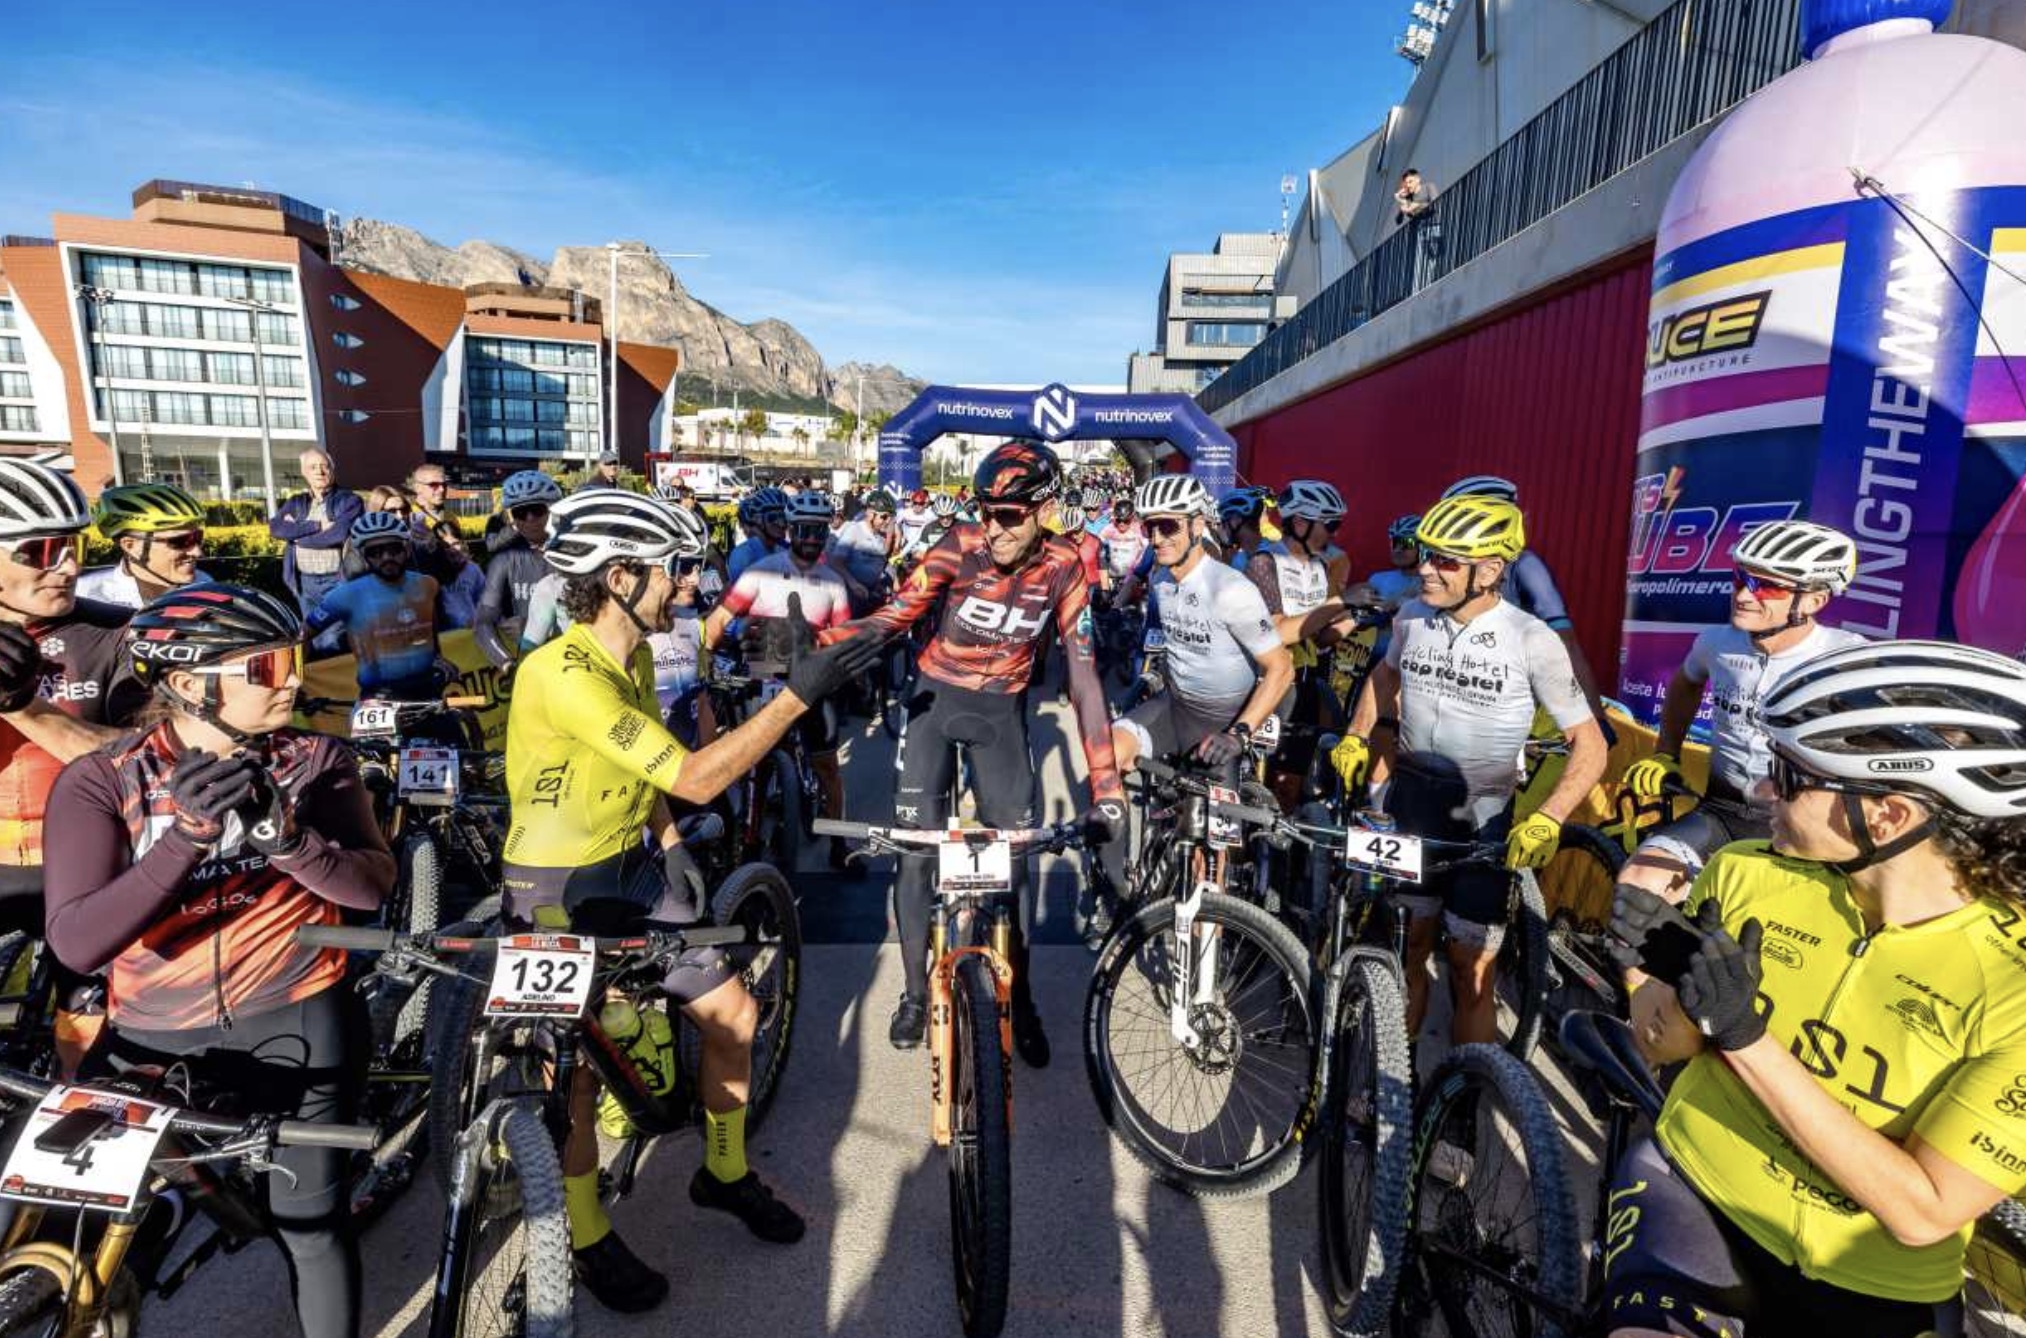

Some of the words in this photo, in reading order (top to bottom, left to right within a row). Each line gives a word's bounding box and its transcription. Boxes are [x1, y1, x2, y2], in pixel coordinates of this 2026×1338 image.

[938, 402, 1013, 420] nutrinovex
[1095, 409, 1173, 423] nutrinovex
[957, 596, 1053, 637] BH
[1461, 653, 1508, 680] Hotel
[357, 709, 387, 725] 161
[408, 763, 449, 784] 141
[1876, 758, 1927, 772] ABUS
[1366, 837, 1402, 861] 42
[1765, 920, 1822, 948] FASTER
[511, 957, 579, 994] 132
[61, 1146, 95, 1176] 4
